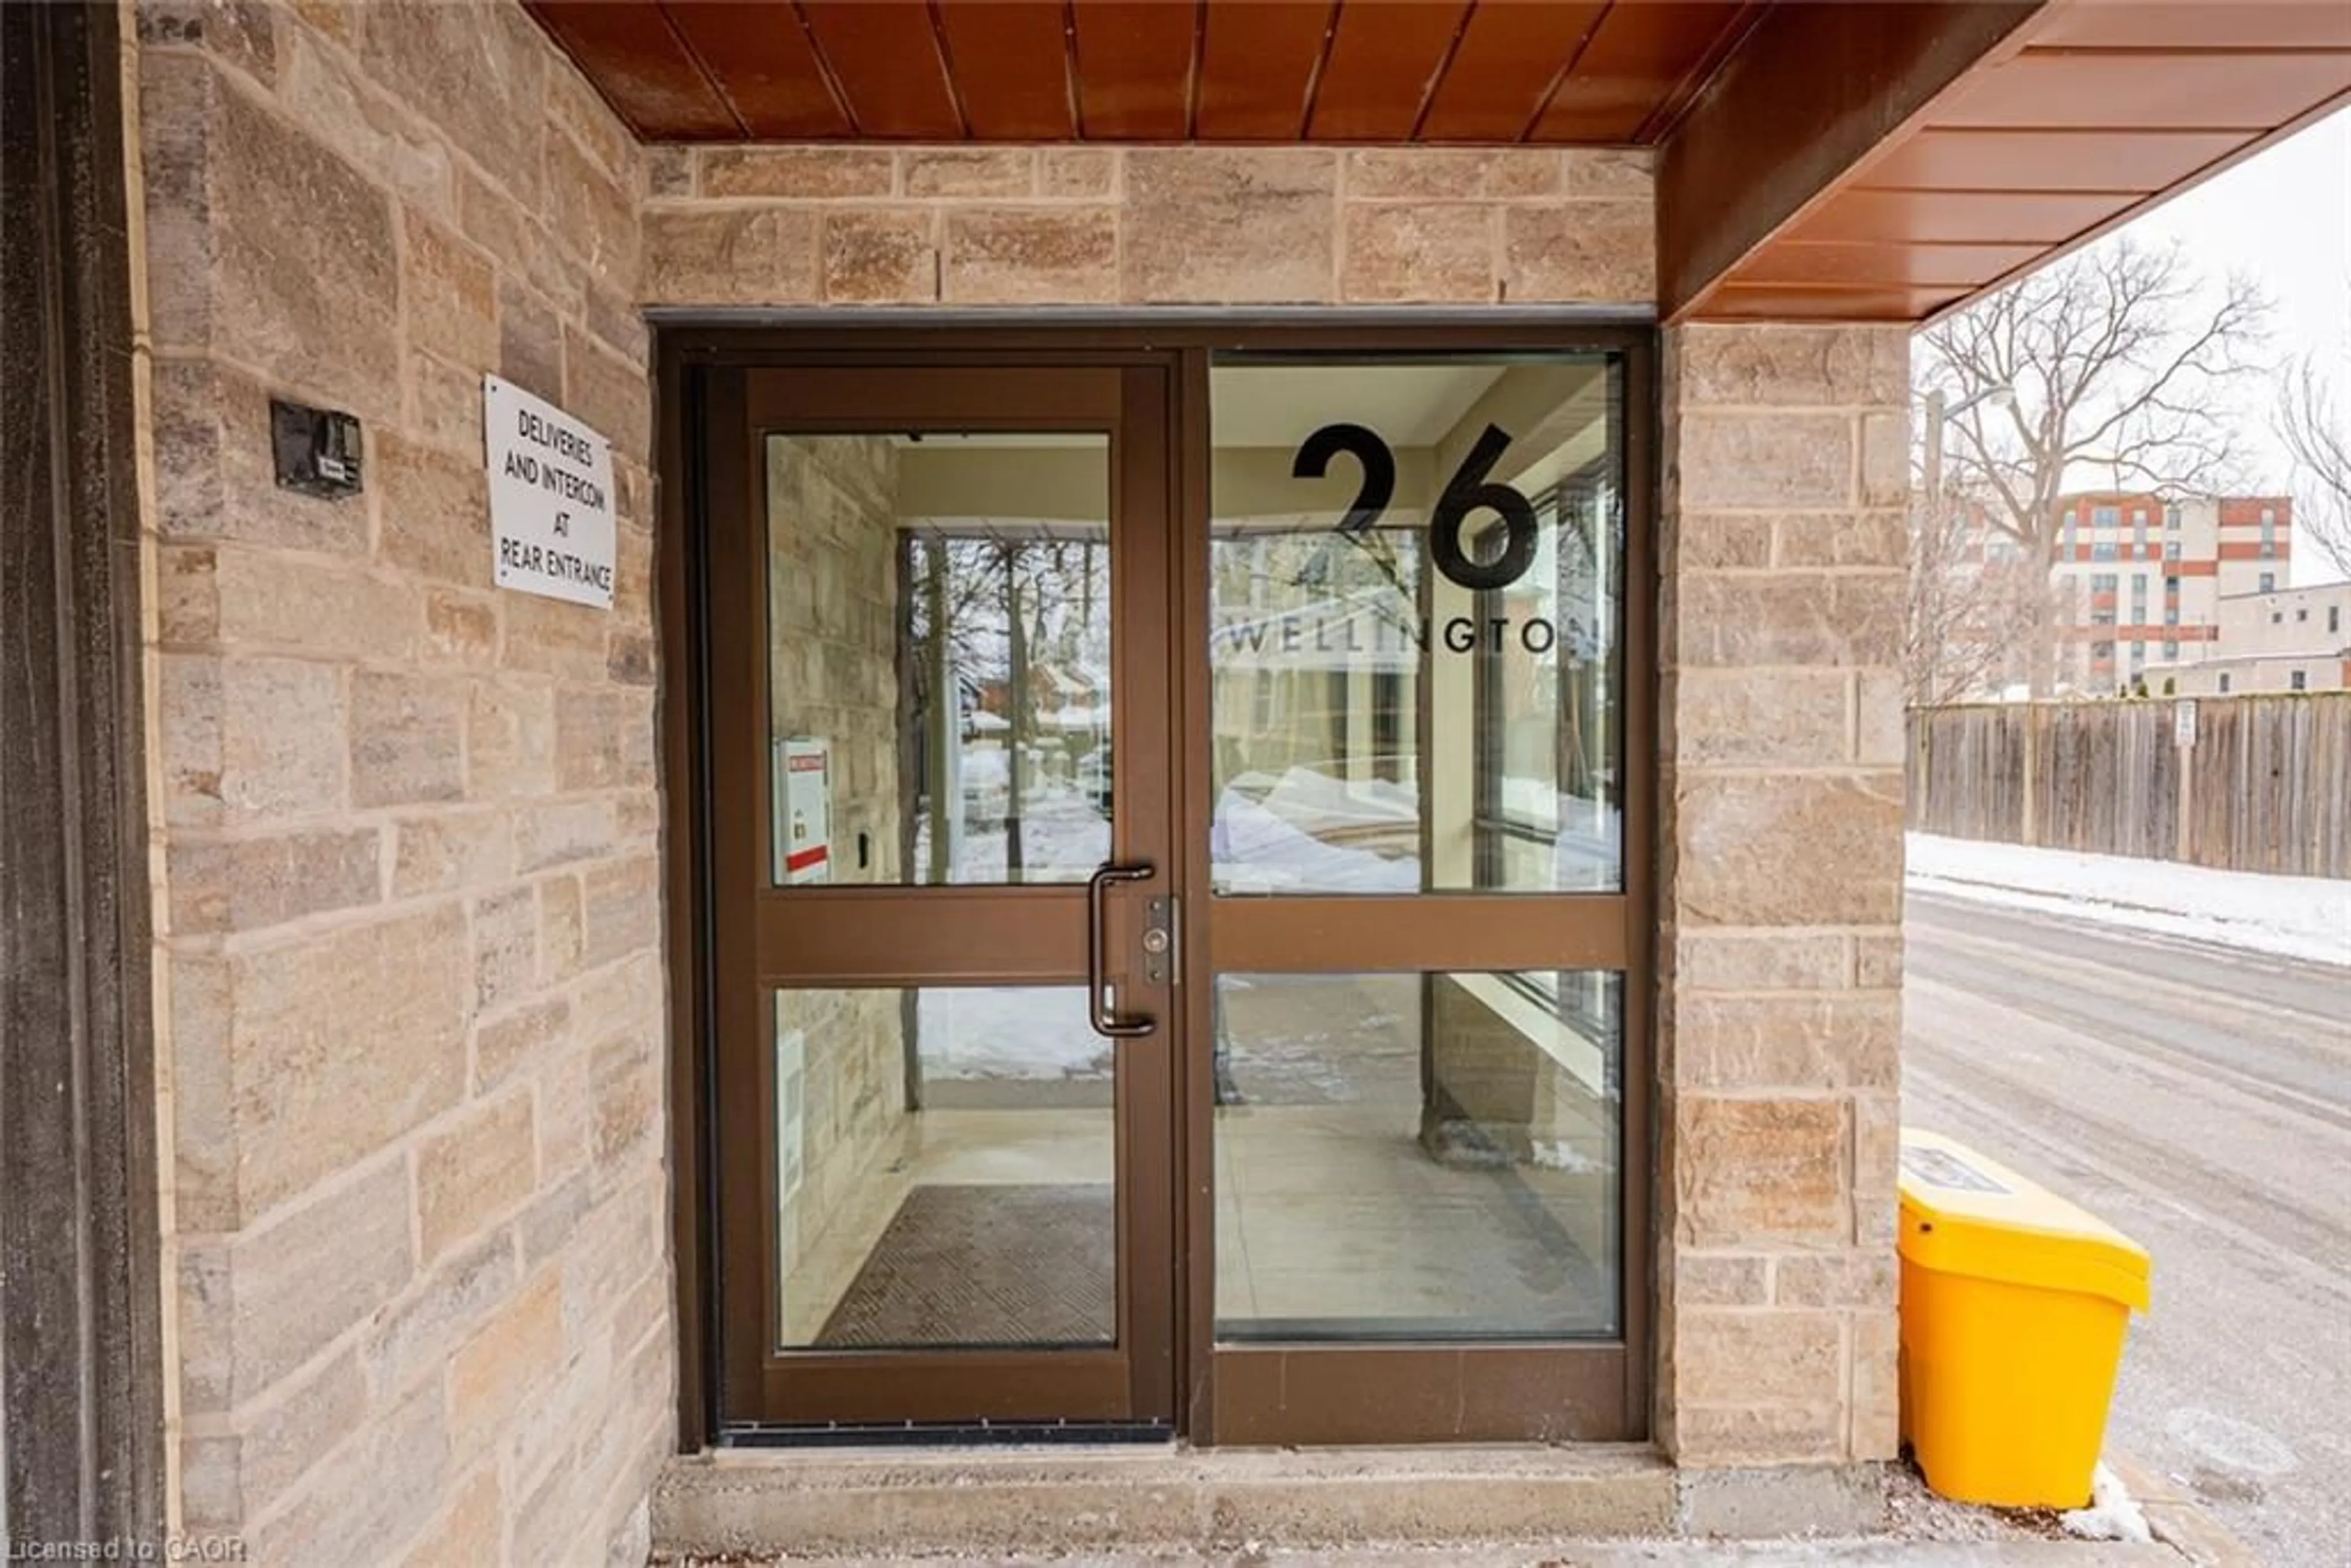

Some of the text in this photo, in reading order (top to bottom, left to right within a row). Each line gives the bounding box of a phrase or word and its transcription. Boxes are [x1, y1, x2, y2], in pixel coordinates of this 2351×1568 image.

[519, 409, 593, 467] DELIVERIES
[505, 449, 605, 512] AND INTERCOM
[1292, 422, 1539, 591] 26
[553, 512, 570, 538] AT
[501, 536, 611, 591] REAR ENTRANCE
